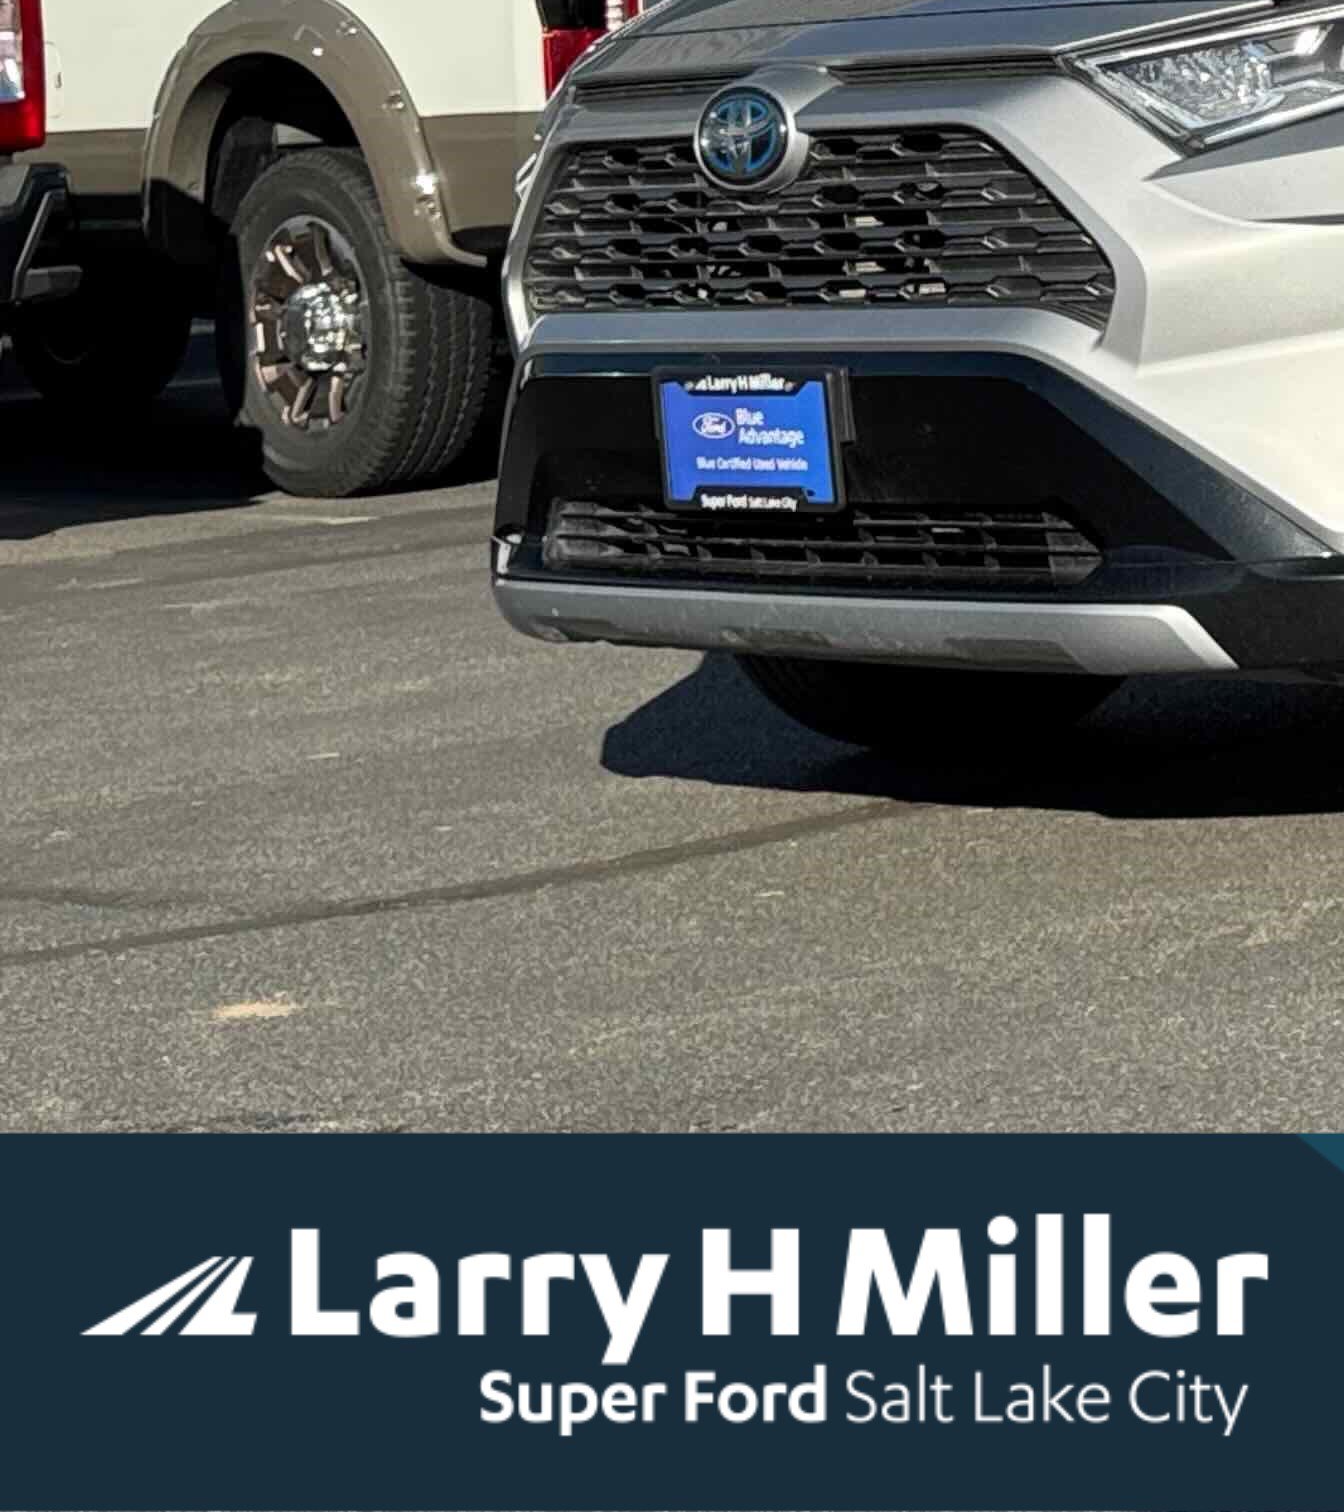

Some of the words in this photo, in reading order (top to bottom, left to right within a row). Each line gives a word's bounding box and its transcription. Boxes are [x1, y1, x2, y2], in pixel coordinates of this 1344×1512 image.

[706, 375, 737, 394] Larry
[735, 407, 765, 426] Blue
[738, 426, 805, 449] Advantage
